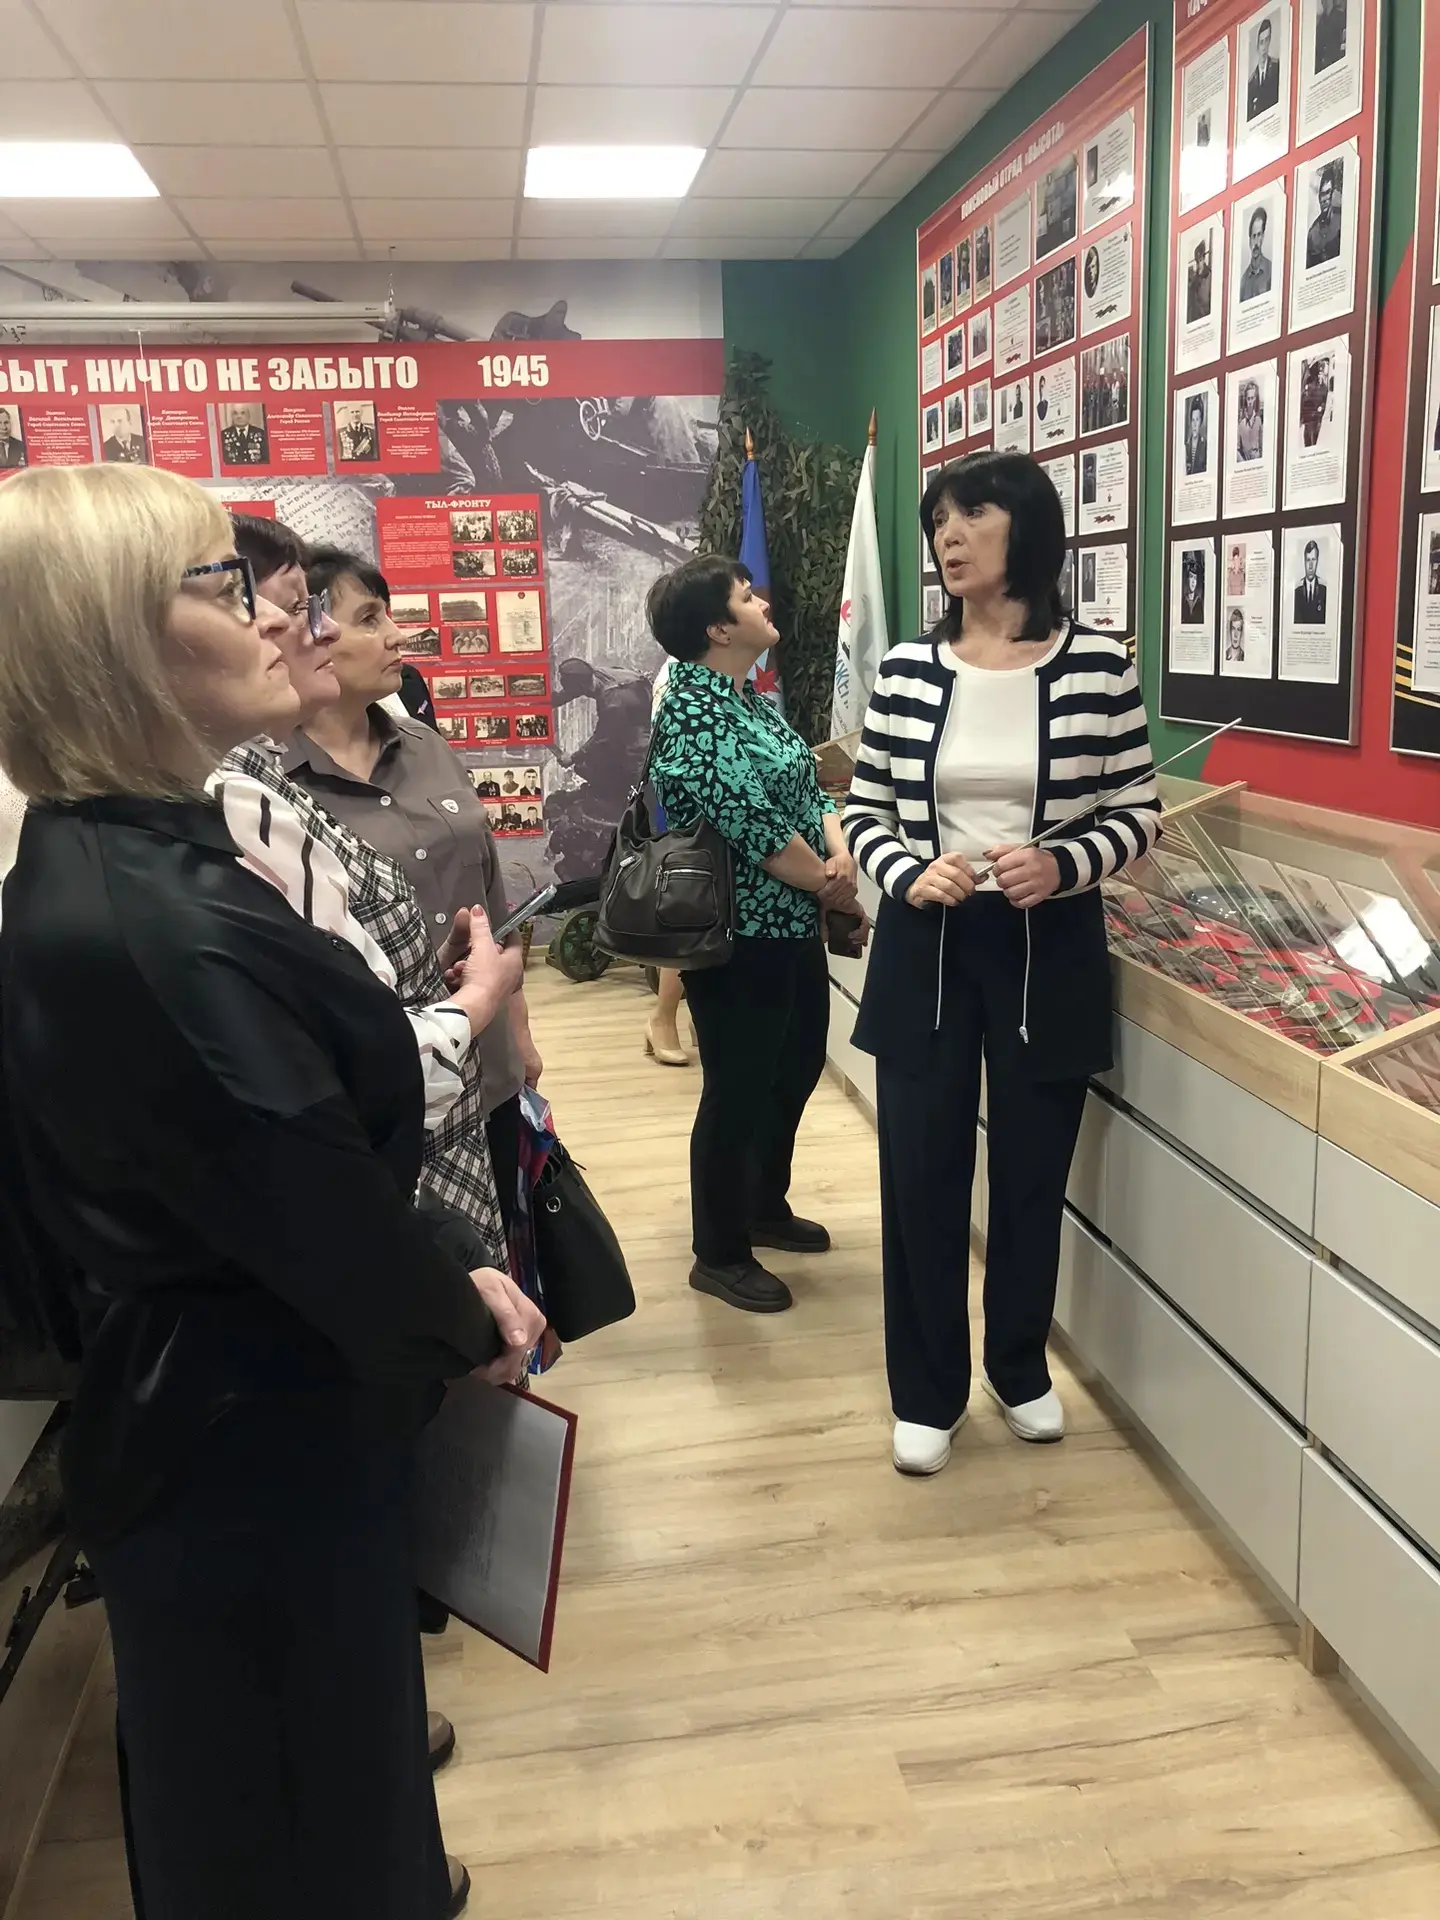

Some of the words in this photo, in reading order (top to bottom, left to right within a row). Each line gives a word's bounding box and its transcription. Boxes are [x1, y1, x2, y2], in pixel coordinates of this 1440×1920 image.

[85, 358, 208, 392] НИЧТО
[216, 357, 261, 391] НЕ
[268, 355, 419, 391] ЗАБЫТО
[477, 354, 550, 388] 1945
[425, 499, 492, 509] ТЫЛ-ФРОНТУ
